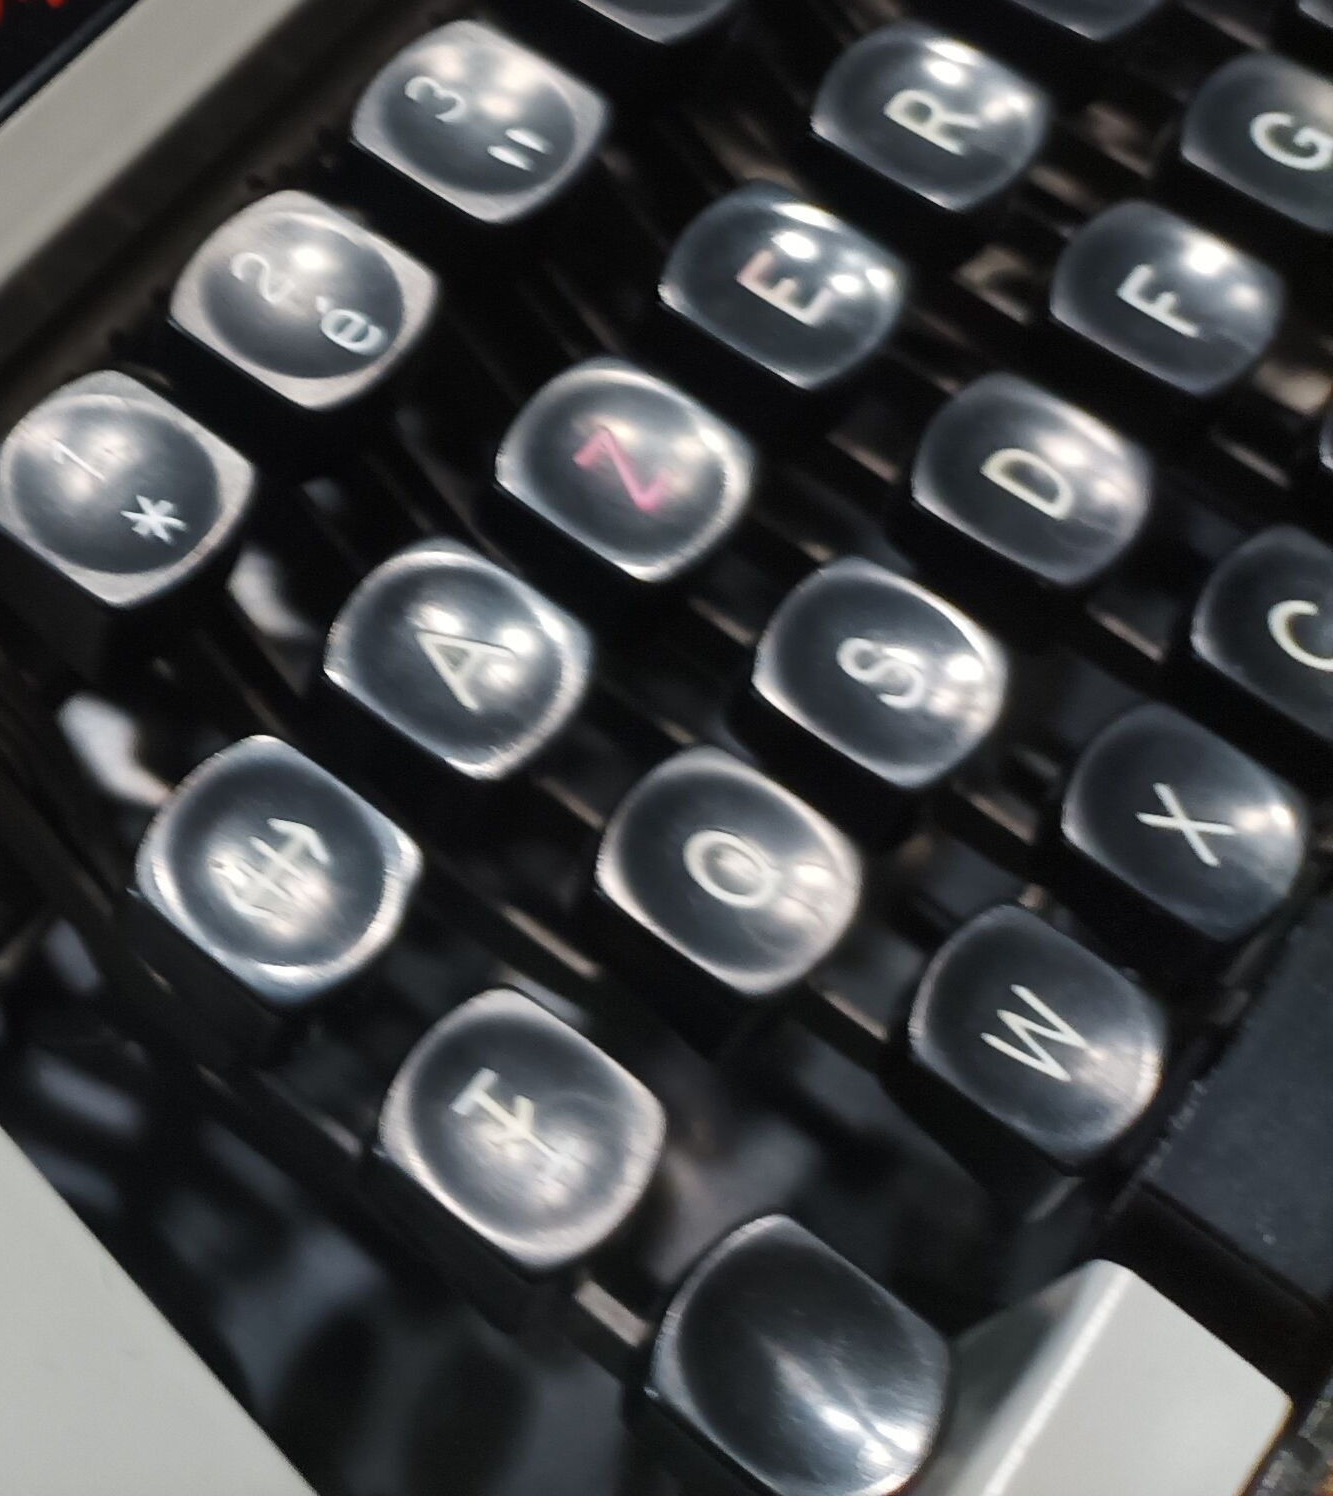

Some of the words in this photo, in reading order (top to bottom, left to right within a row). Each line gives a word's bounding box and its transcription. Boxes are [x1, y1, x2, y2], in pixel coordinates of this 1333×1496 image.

[402, 74, 465, 123] 3
[882, 87, 982, 157] R
[1249, 109, 1333, 171] G
[229, 252, 297, 306] 2
[735, 248, 833, 328] E
[1117, 262, 1201, 339] F
[314, 294, 389, 355] é
[572, 423, 674, 515] Z
[980, 447, 1076, 521] D
[413, 628, 518, 712] A
[836, 636, 929, 711] S
[1136, 781, 1237, 868] X
[980, 984, 1107, 1082] W
